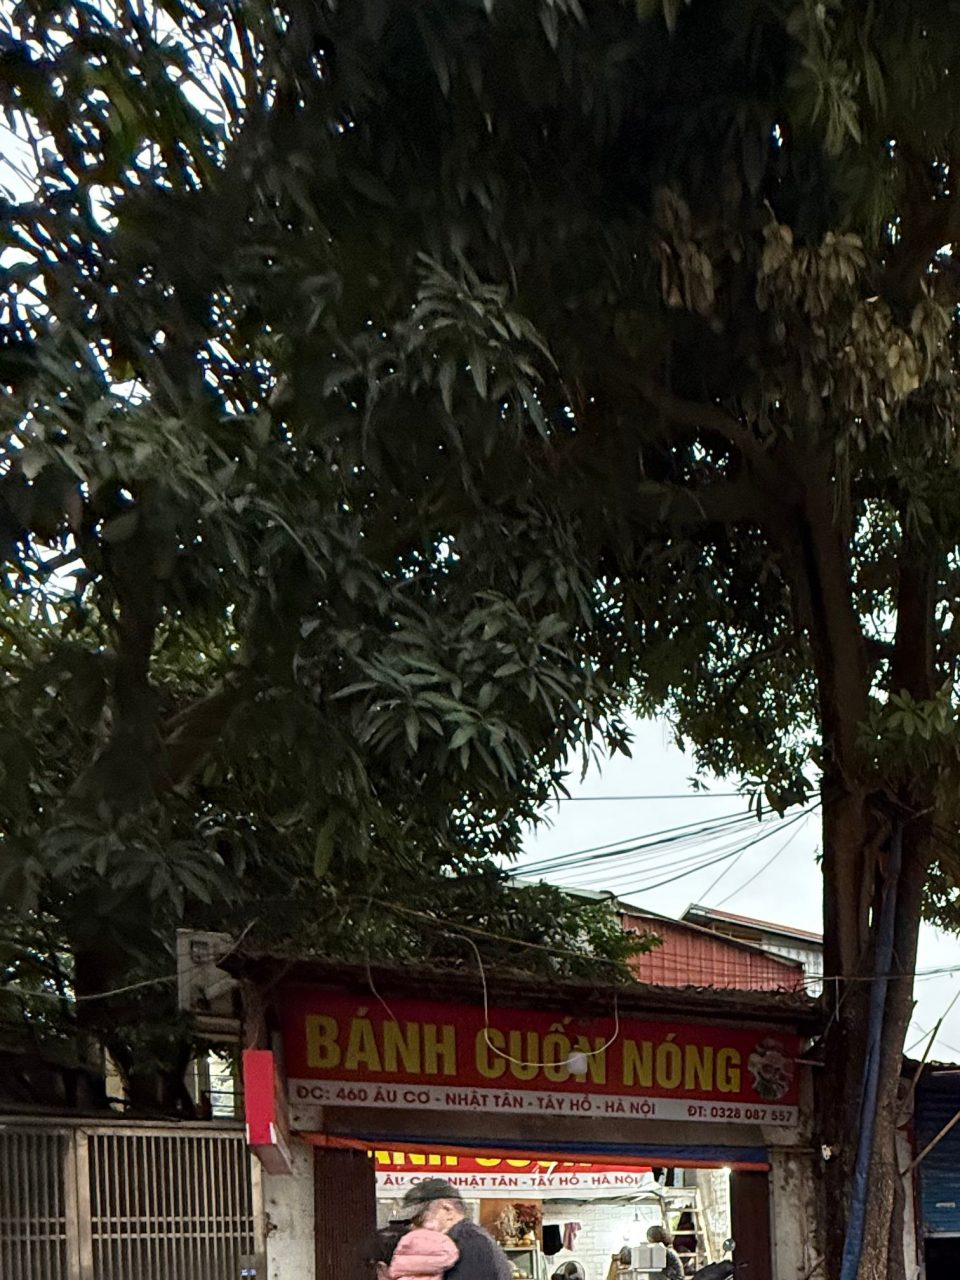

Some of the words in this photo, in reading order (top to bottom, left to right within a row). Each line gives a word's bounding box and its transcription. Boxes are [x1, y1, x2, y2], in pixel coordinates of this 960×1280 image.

[304, 1006, 457, 1076] BÁNH
[475, 1016, 607, 1086] CUỐN
[623, 1033, 741, 1093] NÓNG
[295, 1085, 330, 1100] ĐC:
[336, 1086, 368, 1102] 460
[403, 1087, 431, 1104] CƠ
[445, 1089, 493, 1110] NHẬT
[495, 1091, 524, 1109] TÂN
[535, 1094, 564, 1111] TÂY
[604, 1097, 625, 1114] HÀ
[629, 1099, 656, 1119] NỘI
[687, 1105, 707, 1118] ĐT:
[710, 1106, 741, 1120] 0328
[745, 1106, 767, 1121] 087
[771, 1108, 793, 1122] 557
[383, 1173, 405, 1187] ÂU
[450, 1174, 486, 1189] NHẬT
[491, 1174, 518, 1187] TÂN
[530, 1173, 554, 1187] TÂY
[591, 1174, 611, 1186] HÀ
